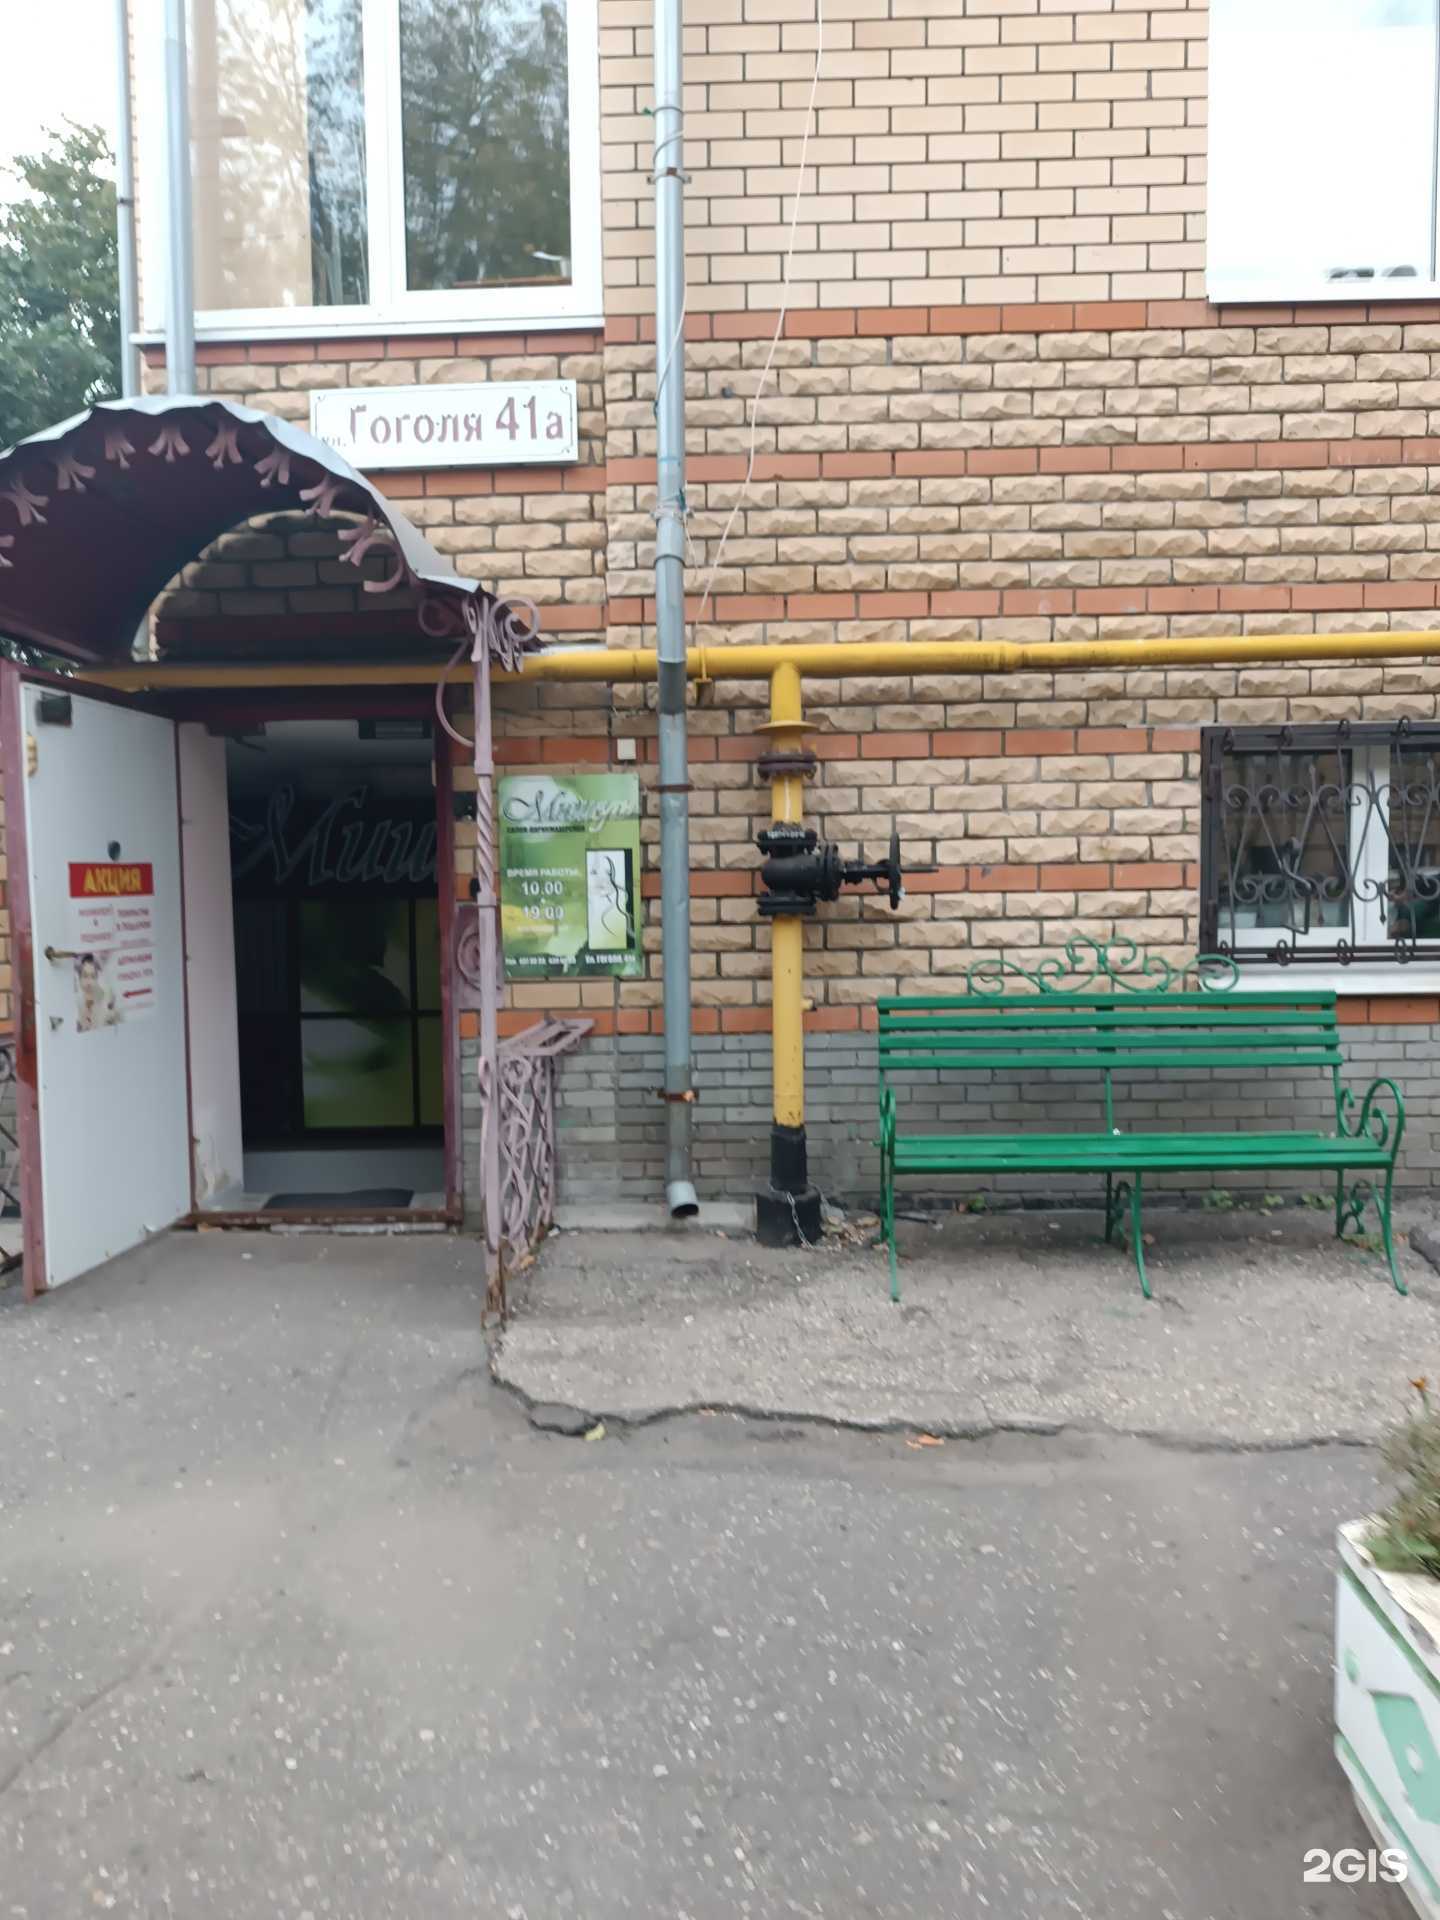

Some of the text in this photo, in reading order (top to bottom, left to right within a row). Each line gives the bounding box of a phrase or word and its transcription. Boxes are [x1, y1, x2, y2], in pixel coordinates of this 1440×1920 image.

[349, 404, 483, 445] Гоголя
[495, 395, 565, 441] 41а
[83, 867, 142, 896] АКЦИЯ
[521, 880, 563, 896] 10.00
